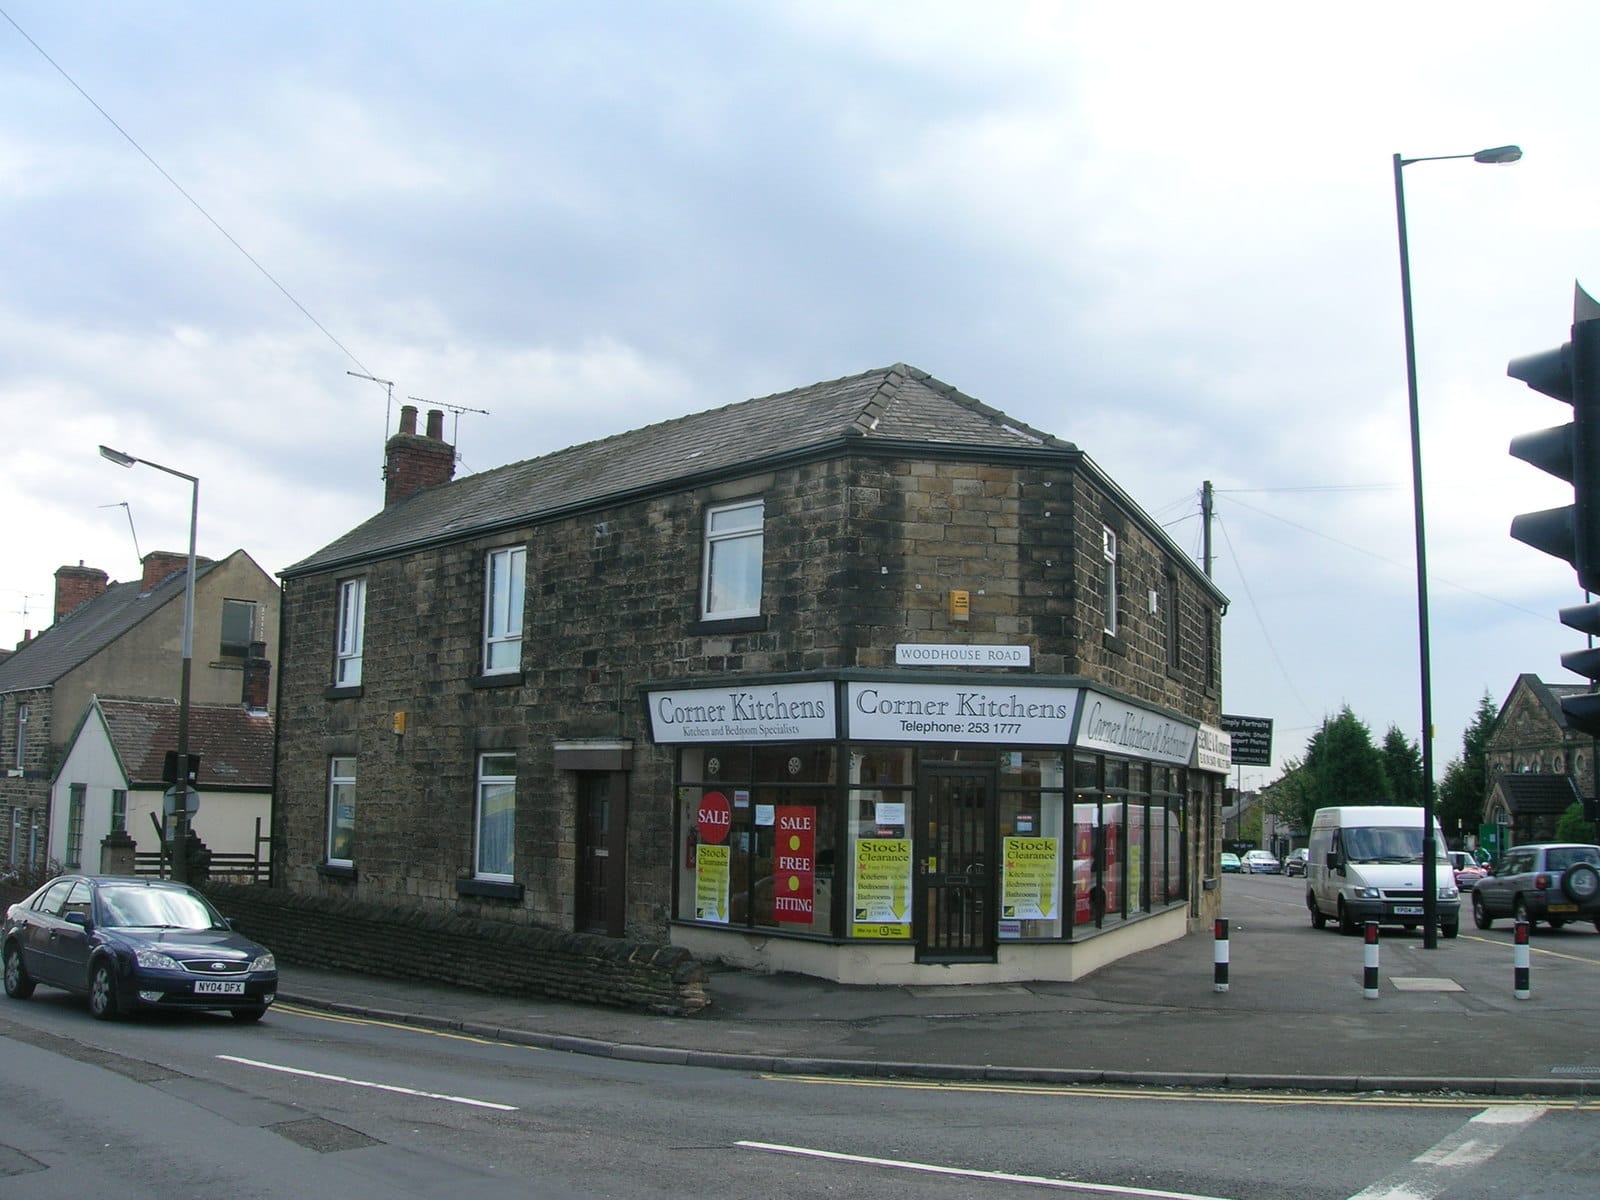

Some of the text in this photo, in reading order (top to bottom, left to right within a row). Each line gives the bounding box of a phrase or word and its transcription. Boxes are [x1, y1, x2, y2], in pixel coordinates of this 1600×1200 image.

[901, 648, 1022, 661] WOODHOUSE ROAD
[657, 691, 826, 724] Corner Kitchens
[856, 689, 1067, 719] Corner Kitchens
[682, 723, 800, 737] Kitchen and Bedroom Specialists
[899, 720, 1022, 735] Telephone: 253 1777
[698, 808, 729, 825] SALE
[780, 816, 811, 830] SALE
[700, 847, 727, 858] Stock
[861, 842, 907, 852] Stock
[1009, 840, 1053, 851] Stock
[859, 853, 910, 862] Clearance
[1007, 851, 1056, 860] Clearance
[779, 857, 811, 871] FREE
[776, 896, 812, 912] FITTING
[198, 982, 242, 993] NY04 DFX
